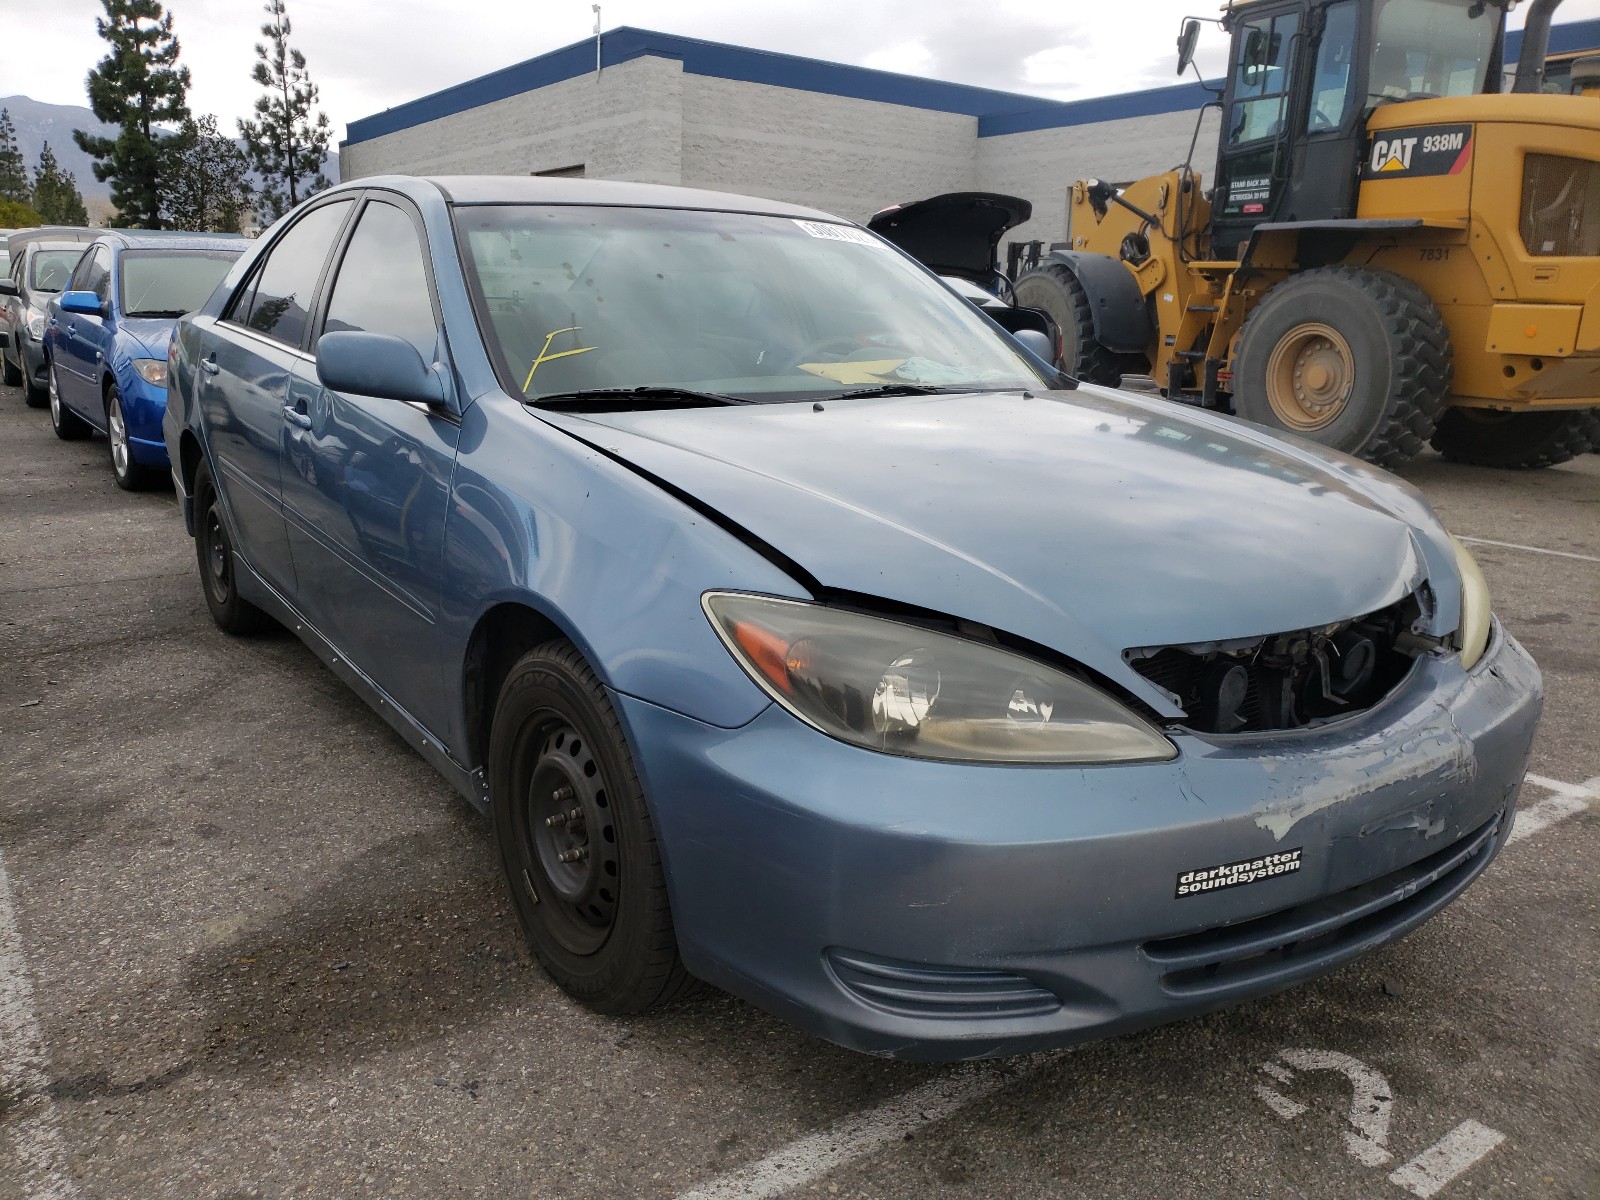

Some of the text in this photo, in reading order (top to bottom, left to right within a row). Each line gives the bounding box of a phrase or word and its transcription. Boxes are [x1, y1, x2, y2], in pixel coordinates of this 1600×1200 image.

[1371, 132, 1464, 172] CAT 938M
[1231, 181, 1246, 189] STAND
[1246, 180, 1259, 188] BACK
[1420, 248, 1450, 261] 7831
[1178, 860, 1300, 894] soundsystem
[1180, 850, 1301, 884] darkmatter
